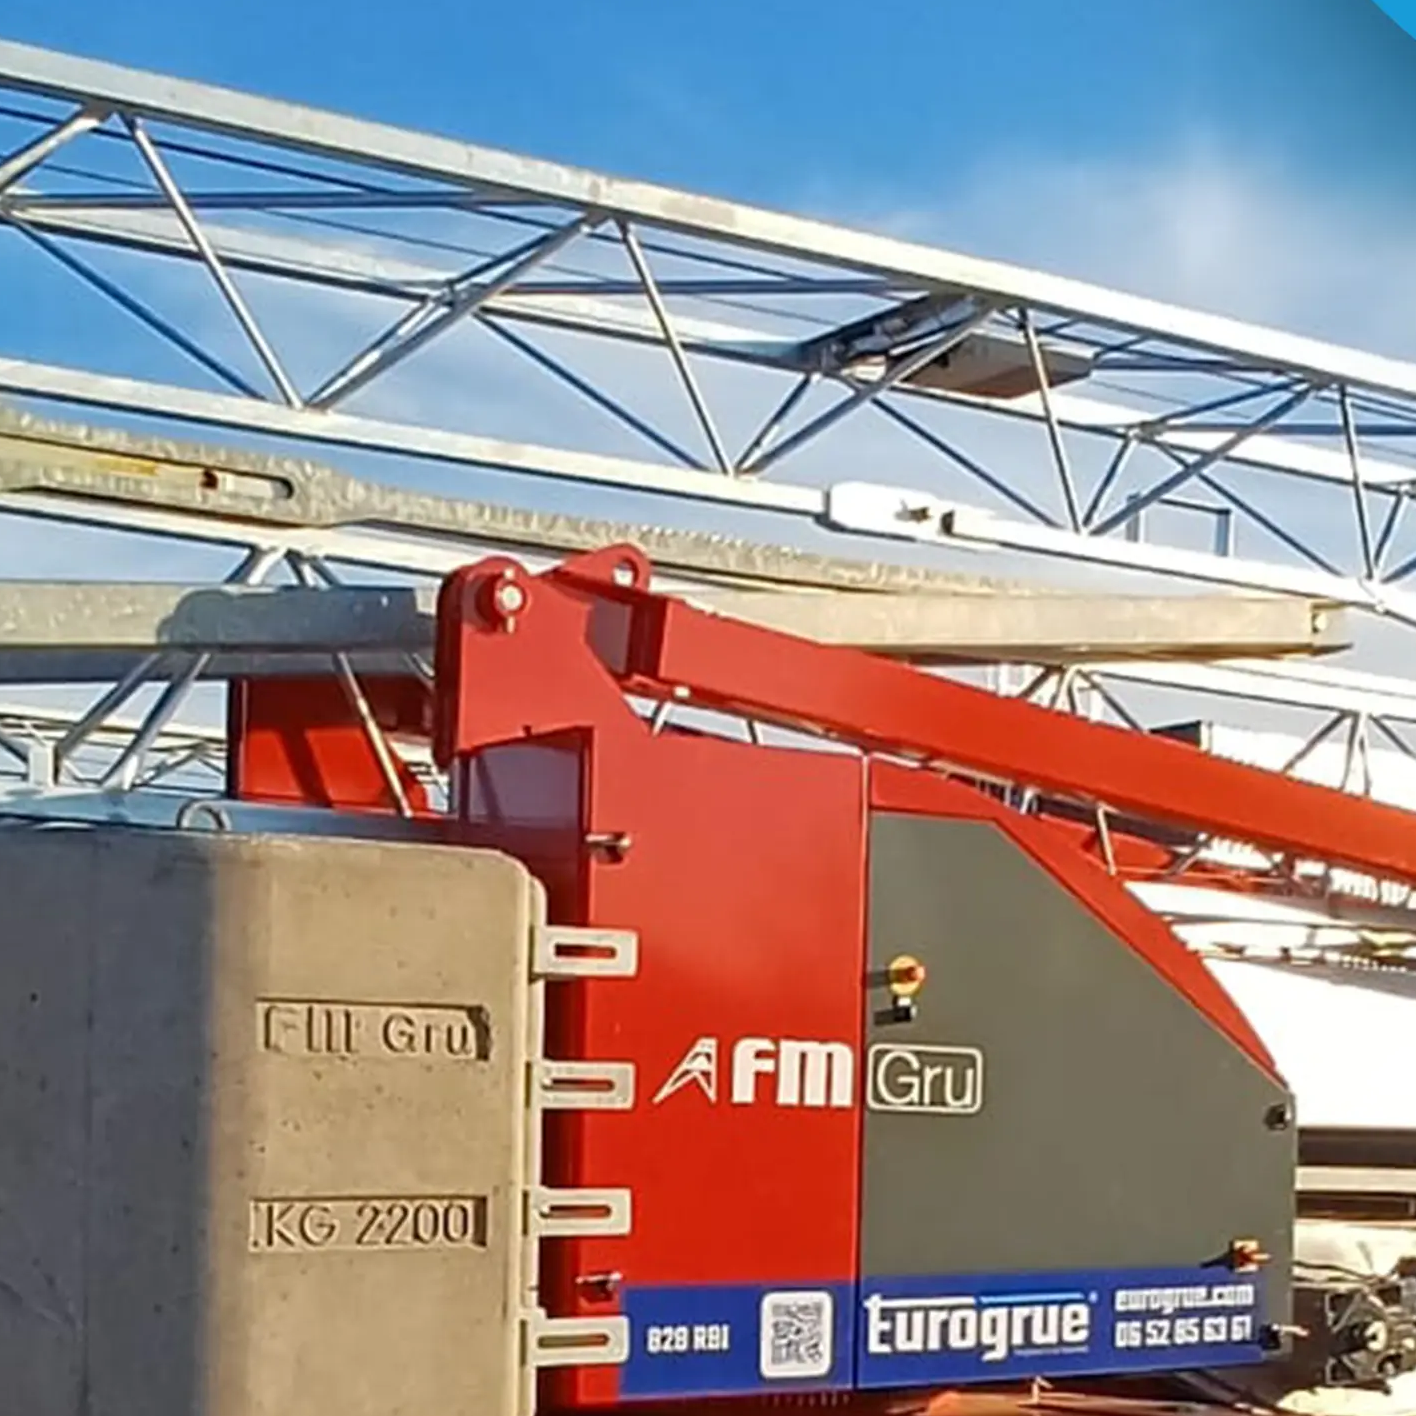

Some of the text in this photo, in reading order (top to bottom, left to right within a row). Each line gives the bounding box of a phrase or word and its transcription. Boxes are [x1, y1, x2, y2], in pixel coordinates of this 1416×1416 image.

[877, 1050, 974, 1106] Gru
[265, 1202, 470, 1247] KG 2200
